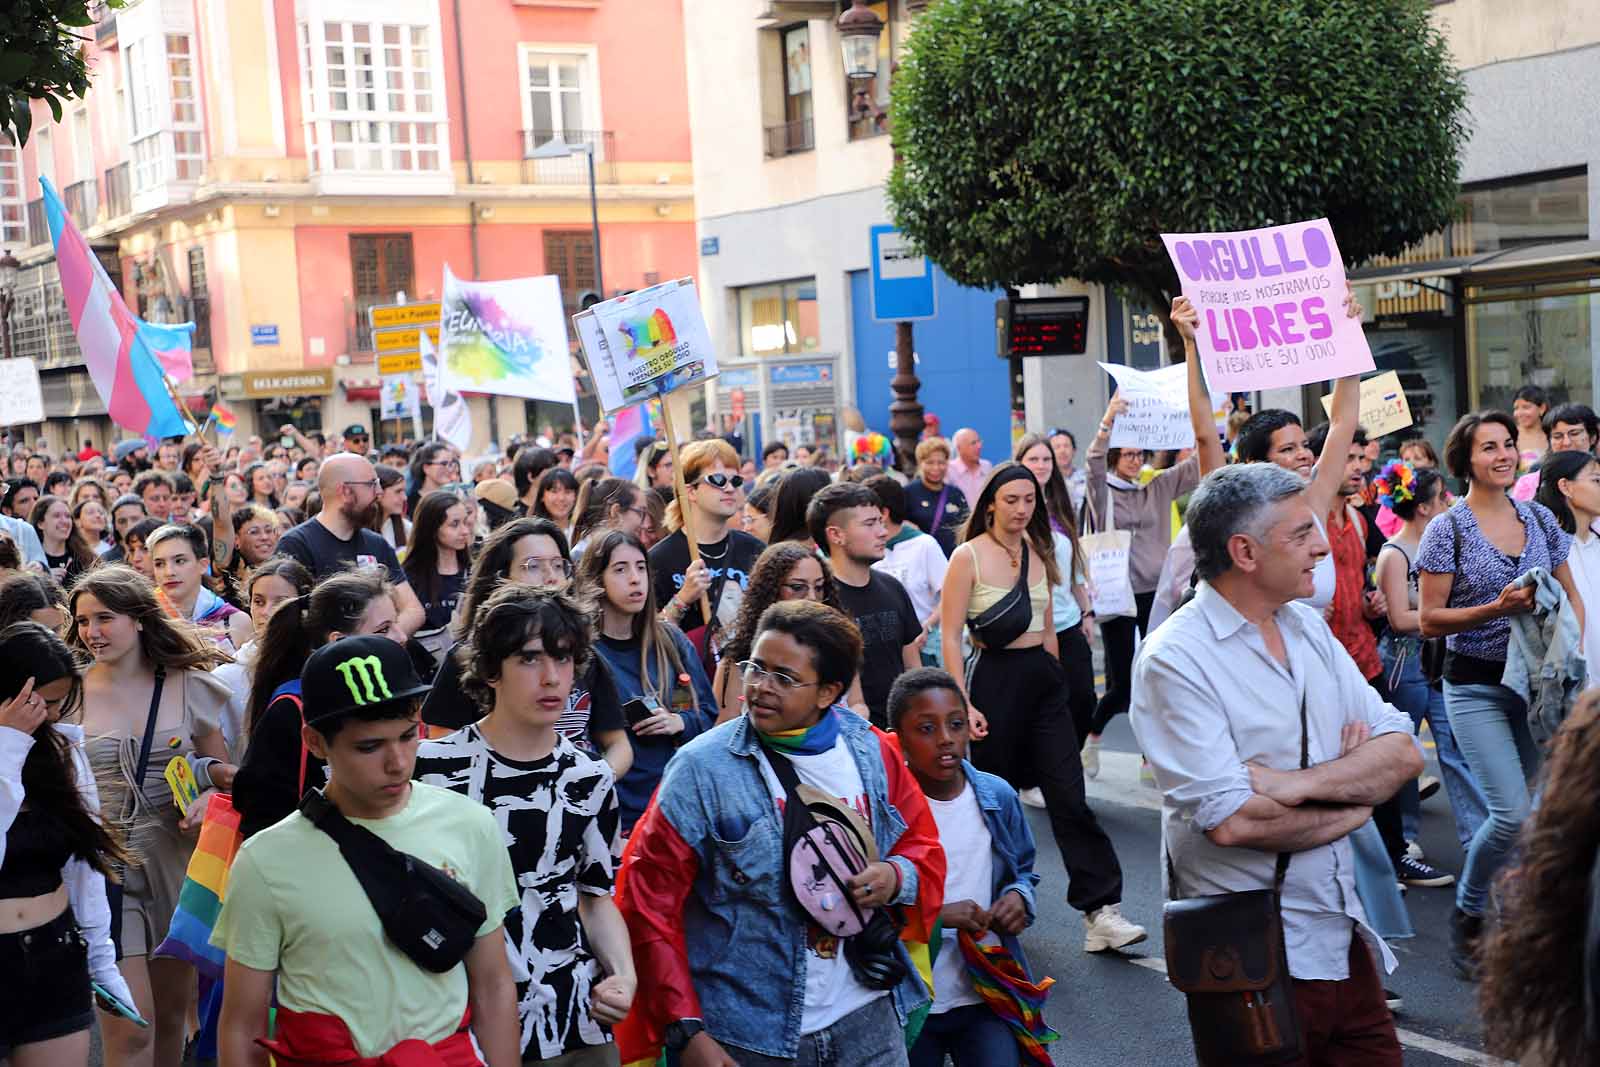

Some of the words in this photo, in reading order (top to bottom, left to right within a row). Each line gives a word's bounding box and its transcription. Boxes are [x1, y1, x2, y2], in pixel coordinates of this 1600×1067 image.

[1174, 227, 1332, 281] ORGULLO
[1255, 275, 1330, 300] MOSTRAMOS
[1206, 296, 1333, 352] LIBRES
[1256, 352, 1273, 369] DE
[1278, 348, 1299, 366] SU
[1305, 340, 1336, 361] ODIO
